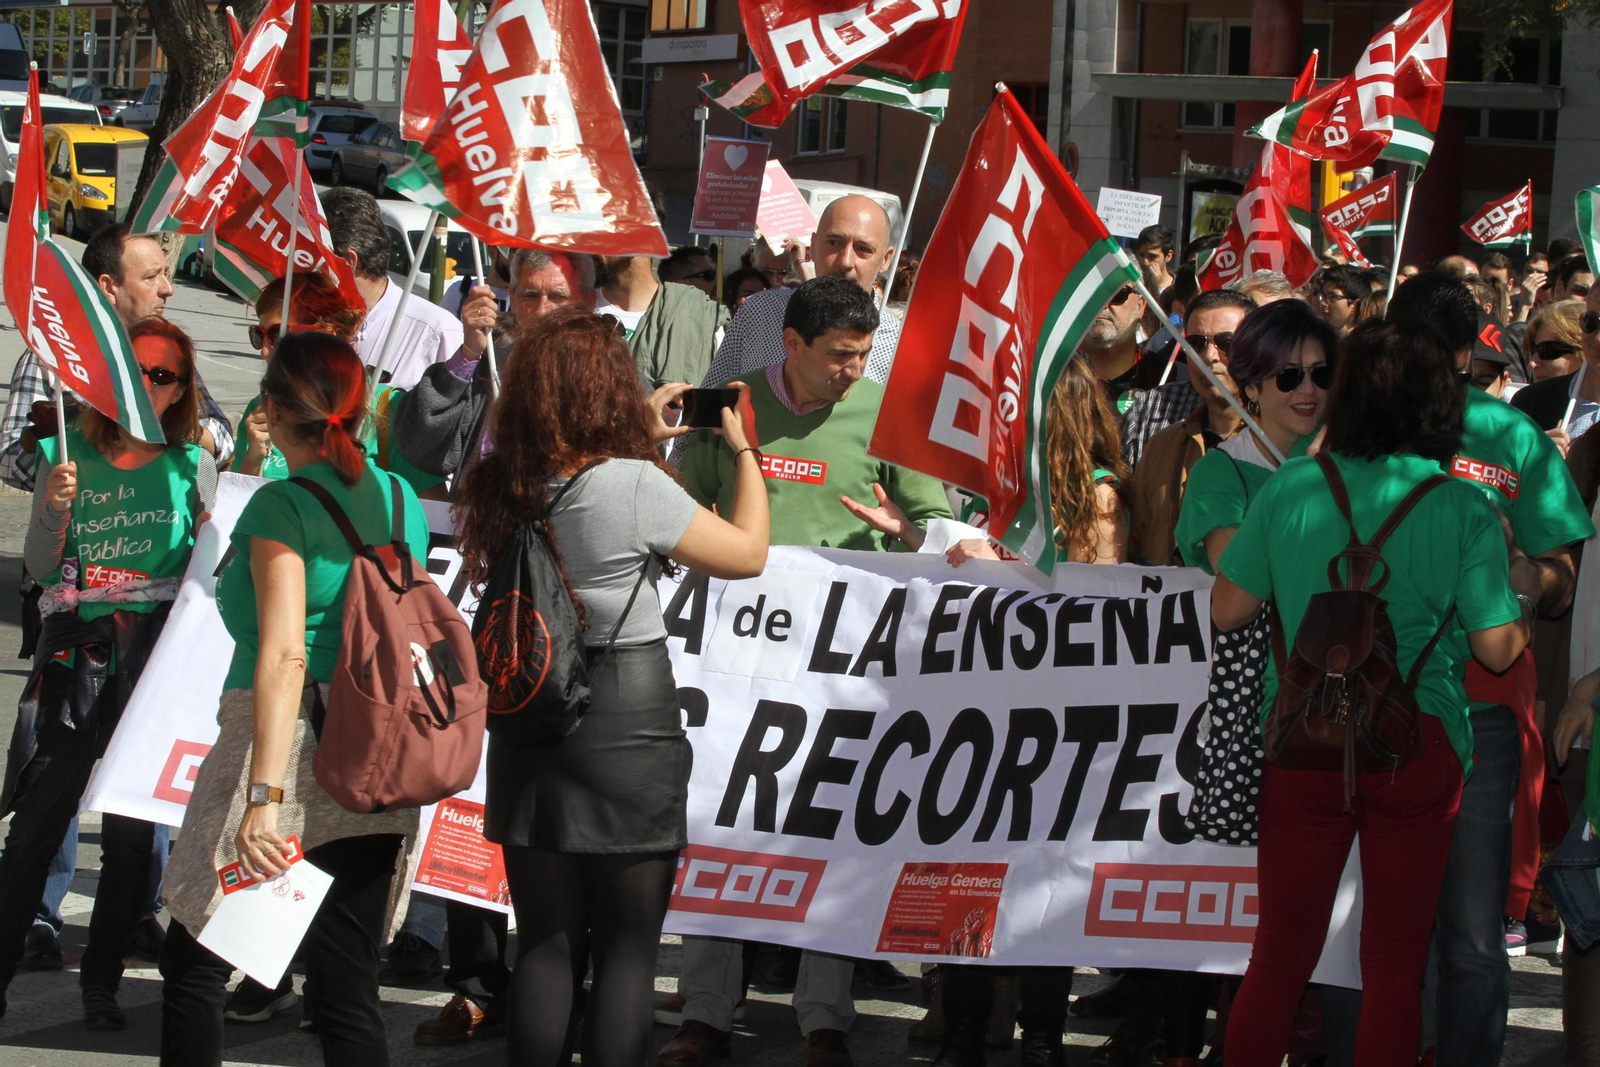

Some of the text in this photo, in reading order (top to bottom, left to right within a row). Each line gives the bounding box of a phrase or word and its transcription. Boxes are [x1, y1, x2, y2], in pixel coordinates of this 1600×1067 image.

[450, 82, 518, 237] Huelva
[706, 172, 733, 180] Eliminar
[775, 472, 801, 480] HUELVA
[1455, 459, 1508, 485] CCOO
[80, 484, 135, 507] Por la
[71, 509, 180, 538] Enseñanza
[78, 536, 152, 562] Pública
[732, 593, 793, 642] de
[806, 581, 908, 678] LA
[919, 575, 1208, 676] ENSEÑA
[468, 886, 487, 895] CCOO
[901, 872, 949, 889] Huelga
[960, 888, 966, 896] la
